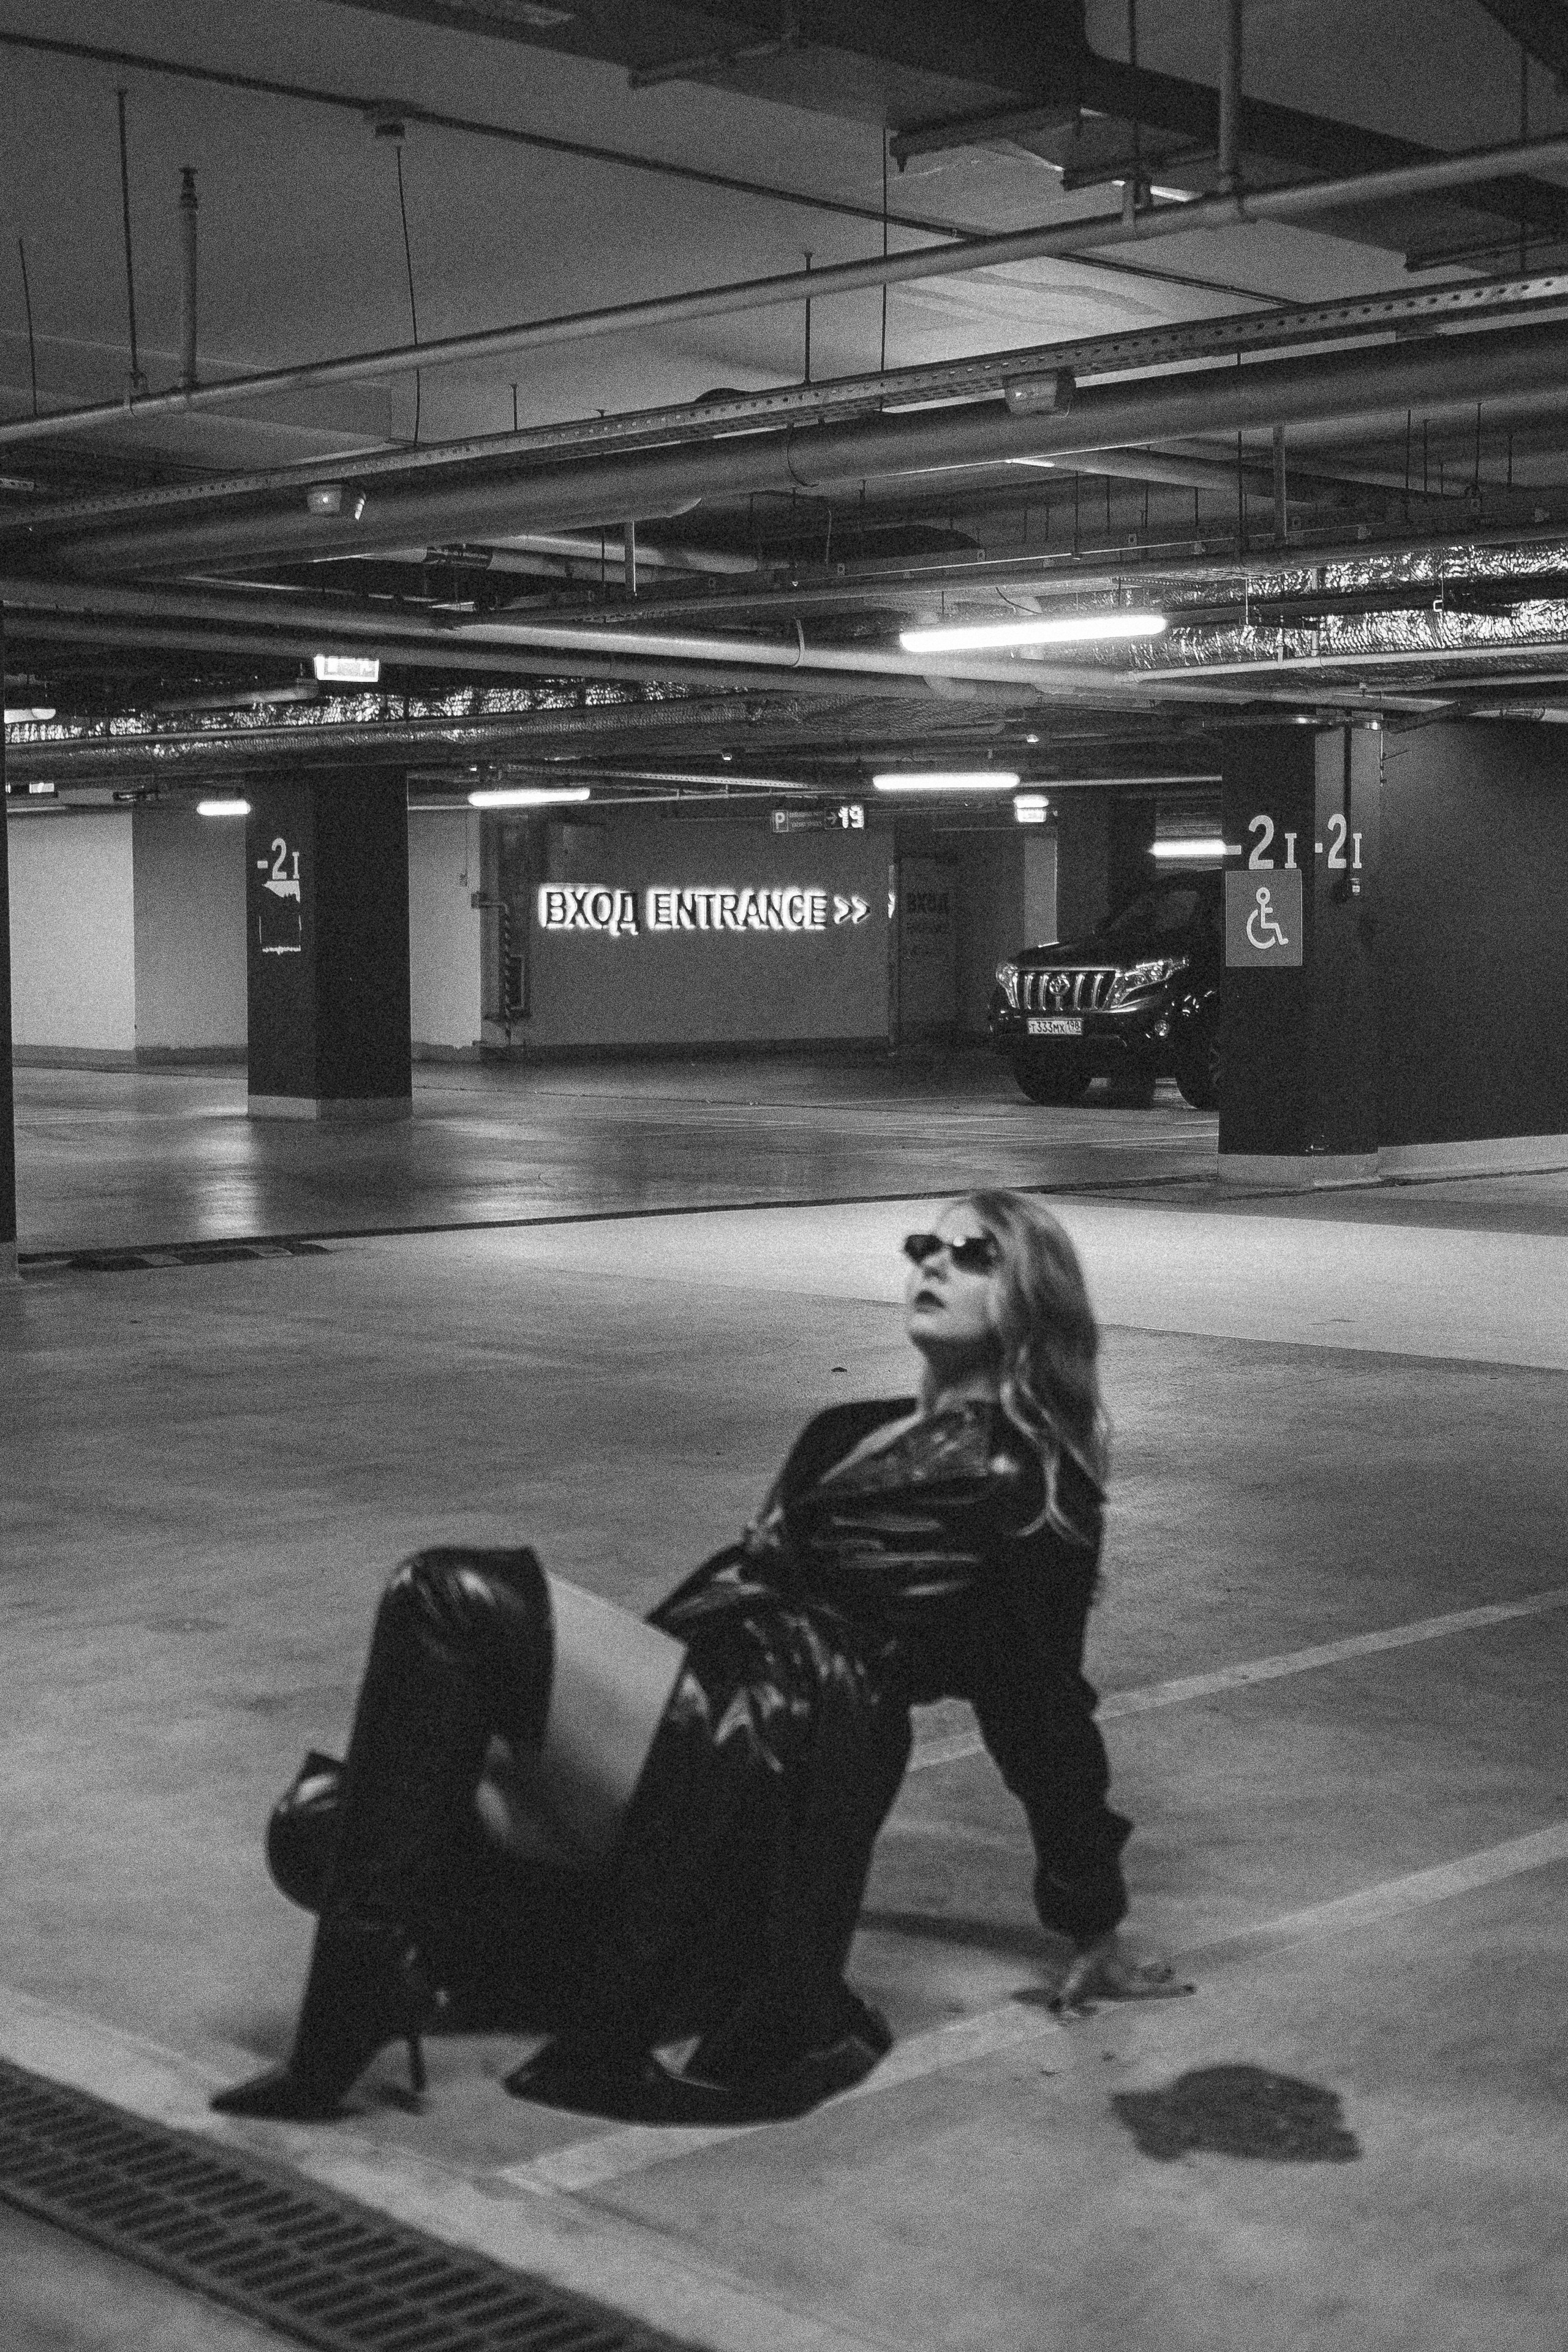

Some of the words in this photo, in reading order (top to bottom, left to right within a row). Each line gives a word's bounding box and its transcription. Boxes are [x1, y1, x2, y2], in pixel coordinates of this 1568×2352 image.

[775, 812, 785, 829] P
[838, 805, 864, 828] 19
[539, 886, 639, 935] ВХОД
[647, 886, 828, 930] ENTRANCE
